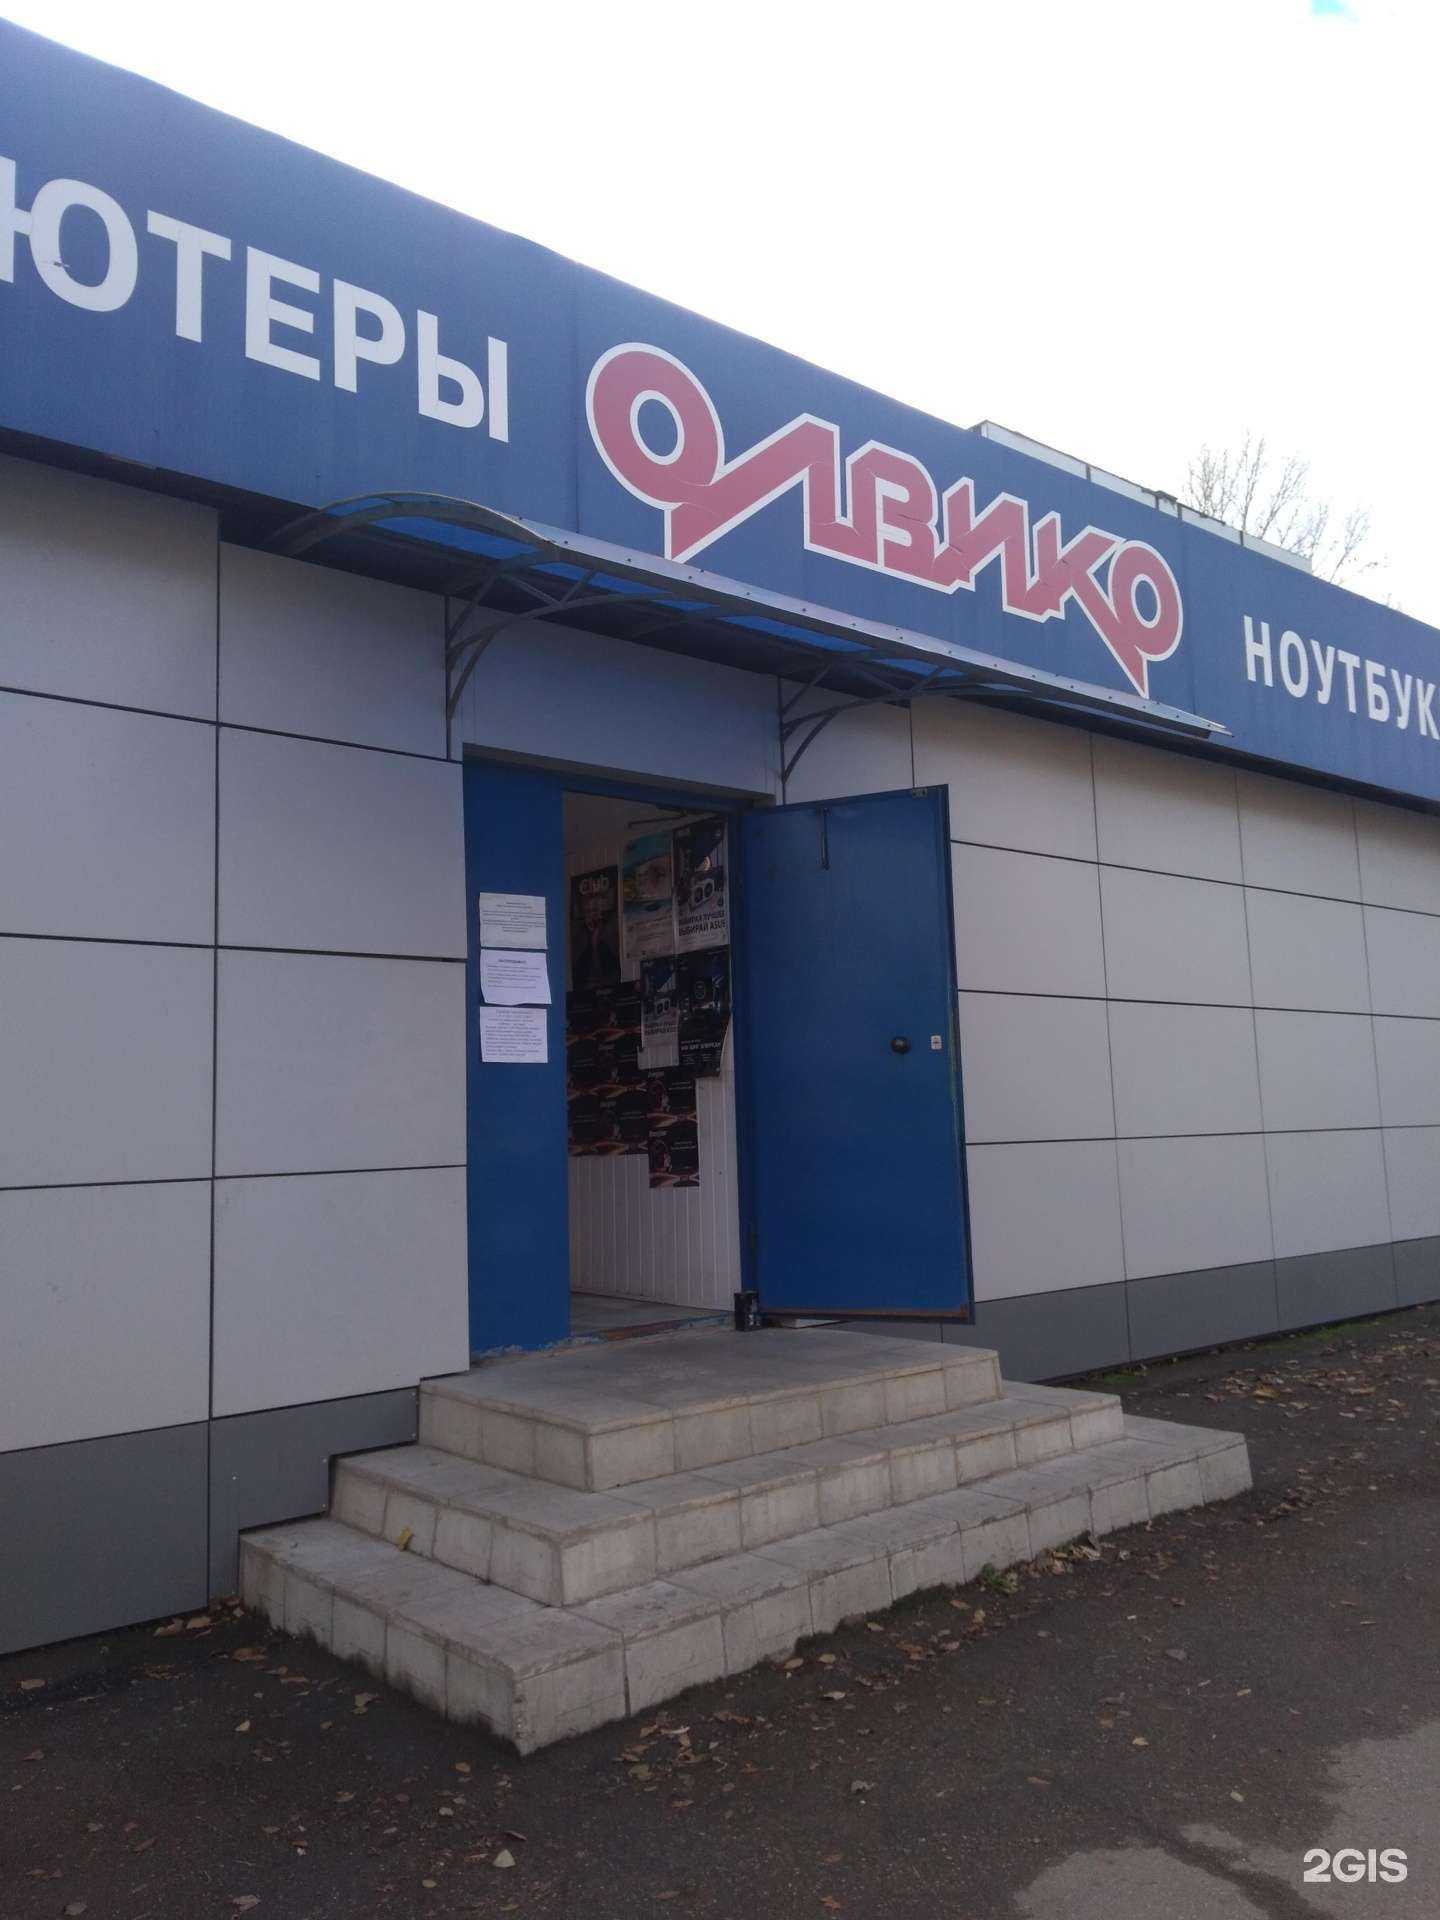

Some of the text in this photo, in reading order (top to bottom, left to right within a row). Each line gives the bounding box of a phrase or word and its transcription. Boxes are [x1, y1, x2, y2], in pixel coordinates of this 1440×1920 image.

[0, 156, 510, 443] ЮТЕРЫ
[586, 342, 1184, 699] ОЛВИКО
[1243, 615, 1440, 741] НОУТБУК
